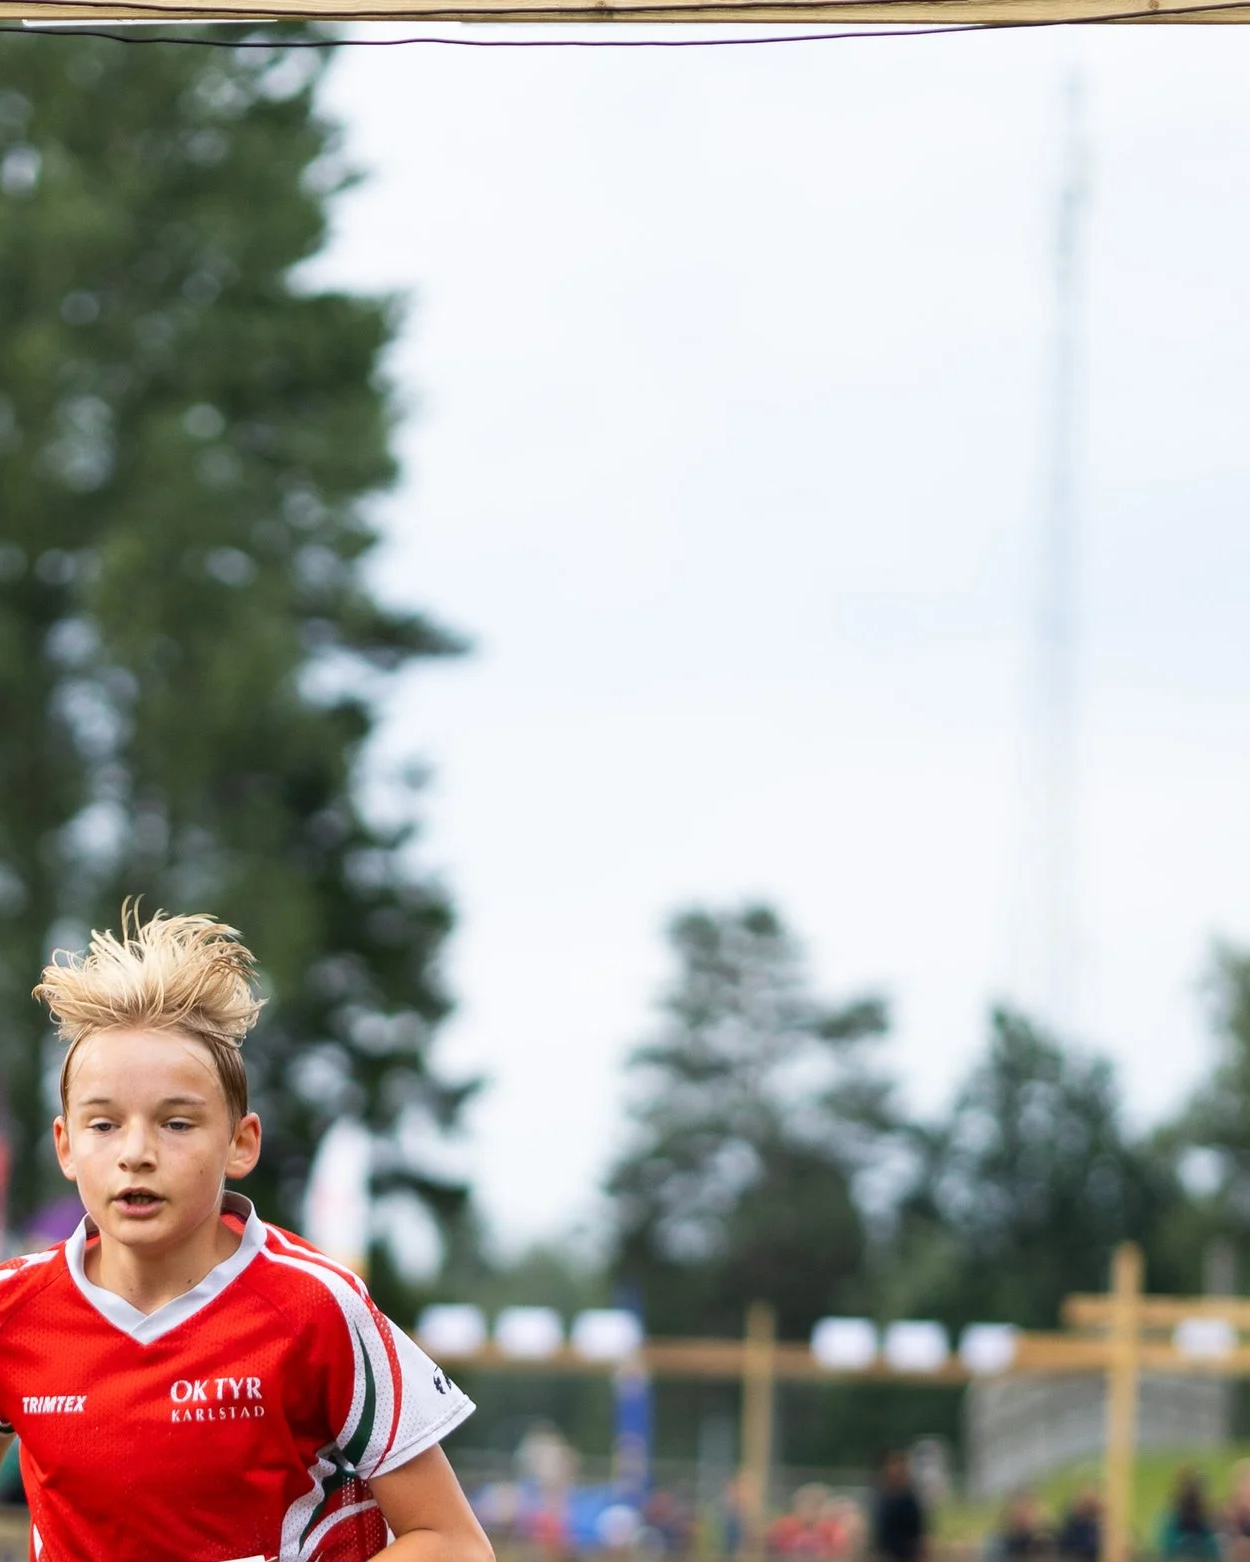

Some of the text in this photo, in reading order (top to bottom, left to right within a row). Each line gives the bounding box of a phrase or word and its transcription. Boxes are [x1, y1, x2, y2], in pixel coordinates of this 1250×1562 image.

[171, 1377, 262, 1403] OK TYR
[22, 1395, 87, 1414] TRIMTEX
[171, 1405, 265, 1422] KARLSTAD
